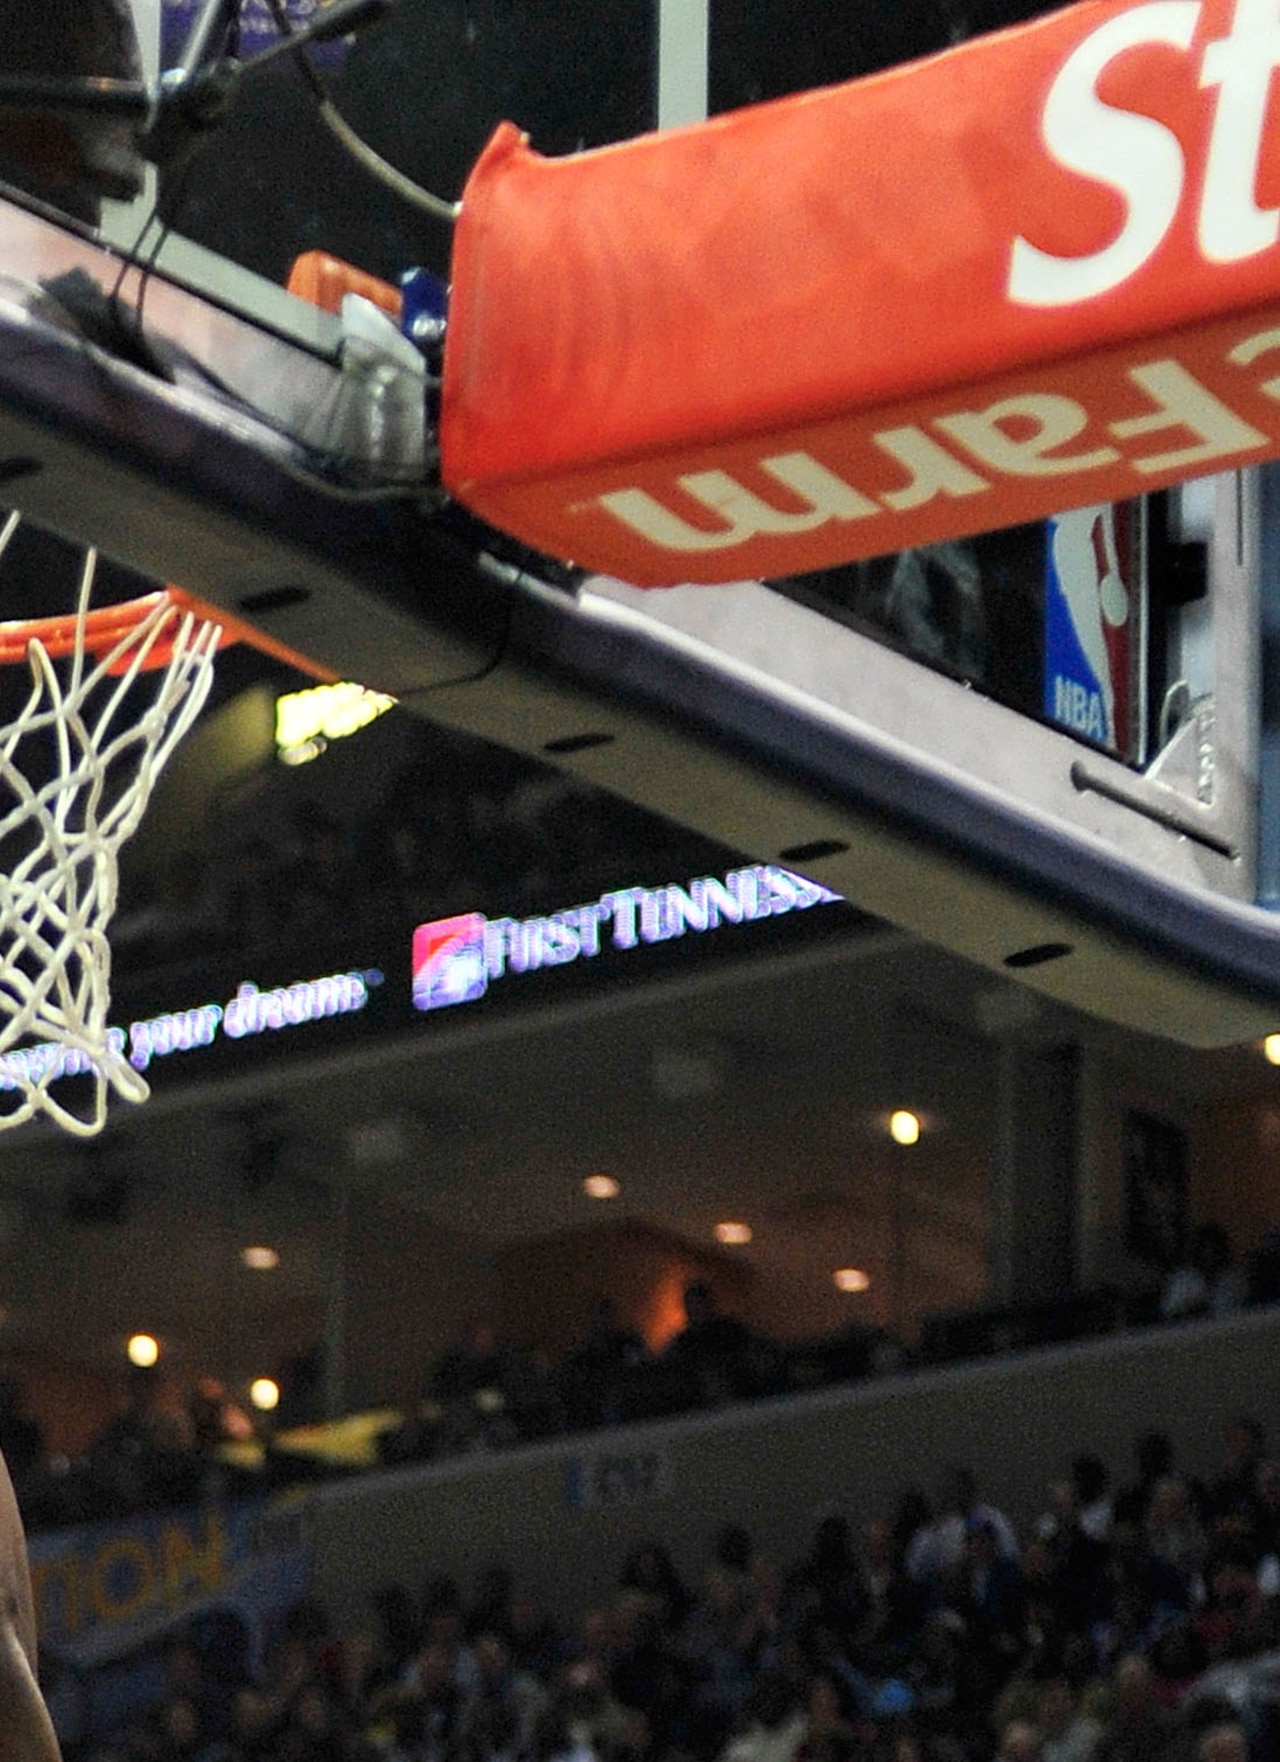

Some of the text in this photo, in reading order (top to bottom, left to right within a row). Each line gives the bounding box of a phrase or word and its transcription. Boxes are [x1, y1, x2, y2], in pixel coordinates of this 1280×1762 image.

[598, 358, 1271, 552] Farm
[1054, 674, 1104, 740] NBA
[486, 904, 609, 979] FIRST
